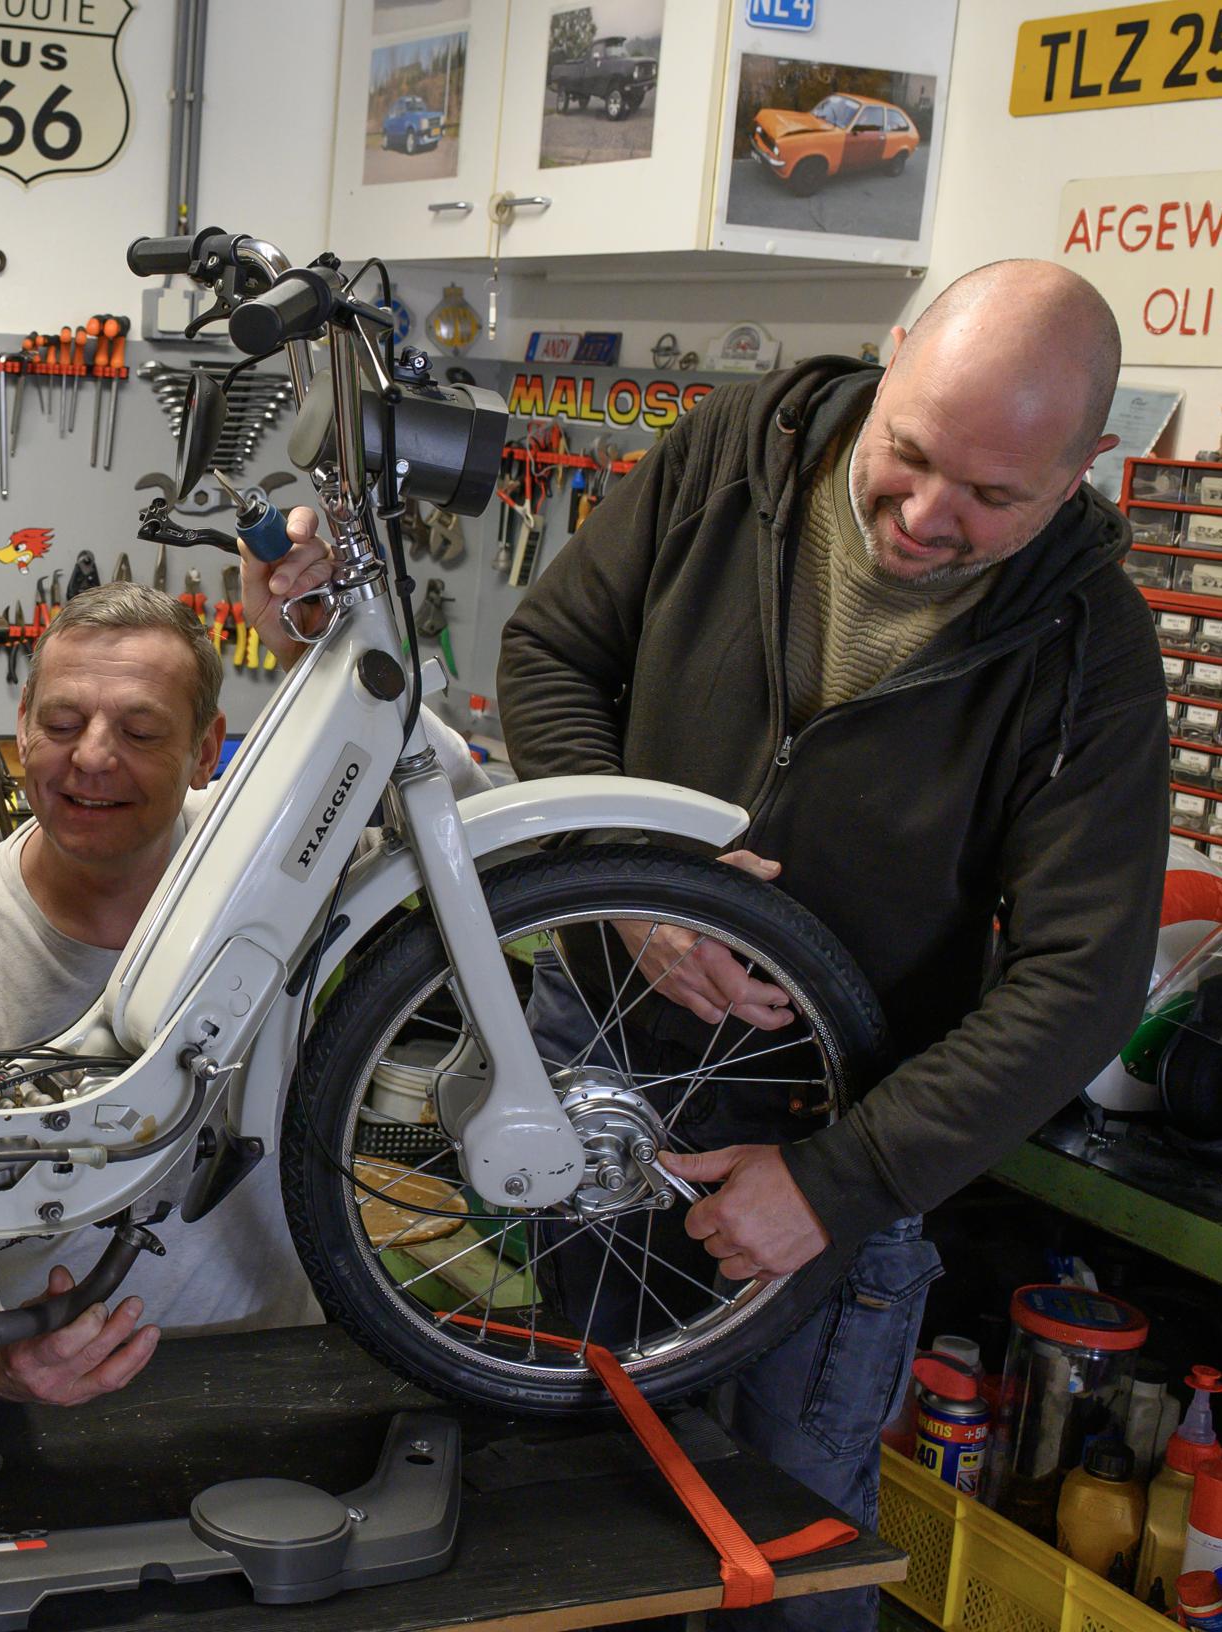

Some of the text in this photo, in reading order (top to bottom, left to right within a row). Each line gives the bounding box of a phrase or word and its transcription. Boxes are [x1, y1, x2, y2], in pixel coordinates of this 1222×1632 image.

[0, 39, 68, 71] US
[1040, 19, 1150, 103] TLZ
[1064, 200, 1222, 253] AFGEW
[1143, 287, 1214, 336] OLI
[297, 762, 360, 868] PIAGGIO
